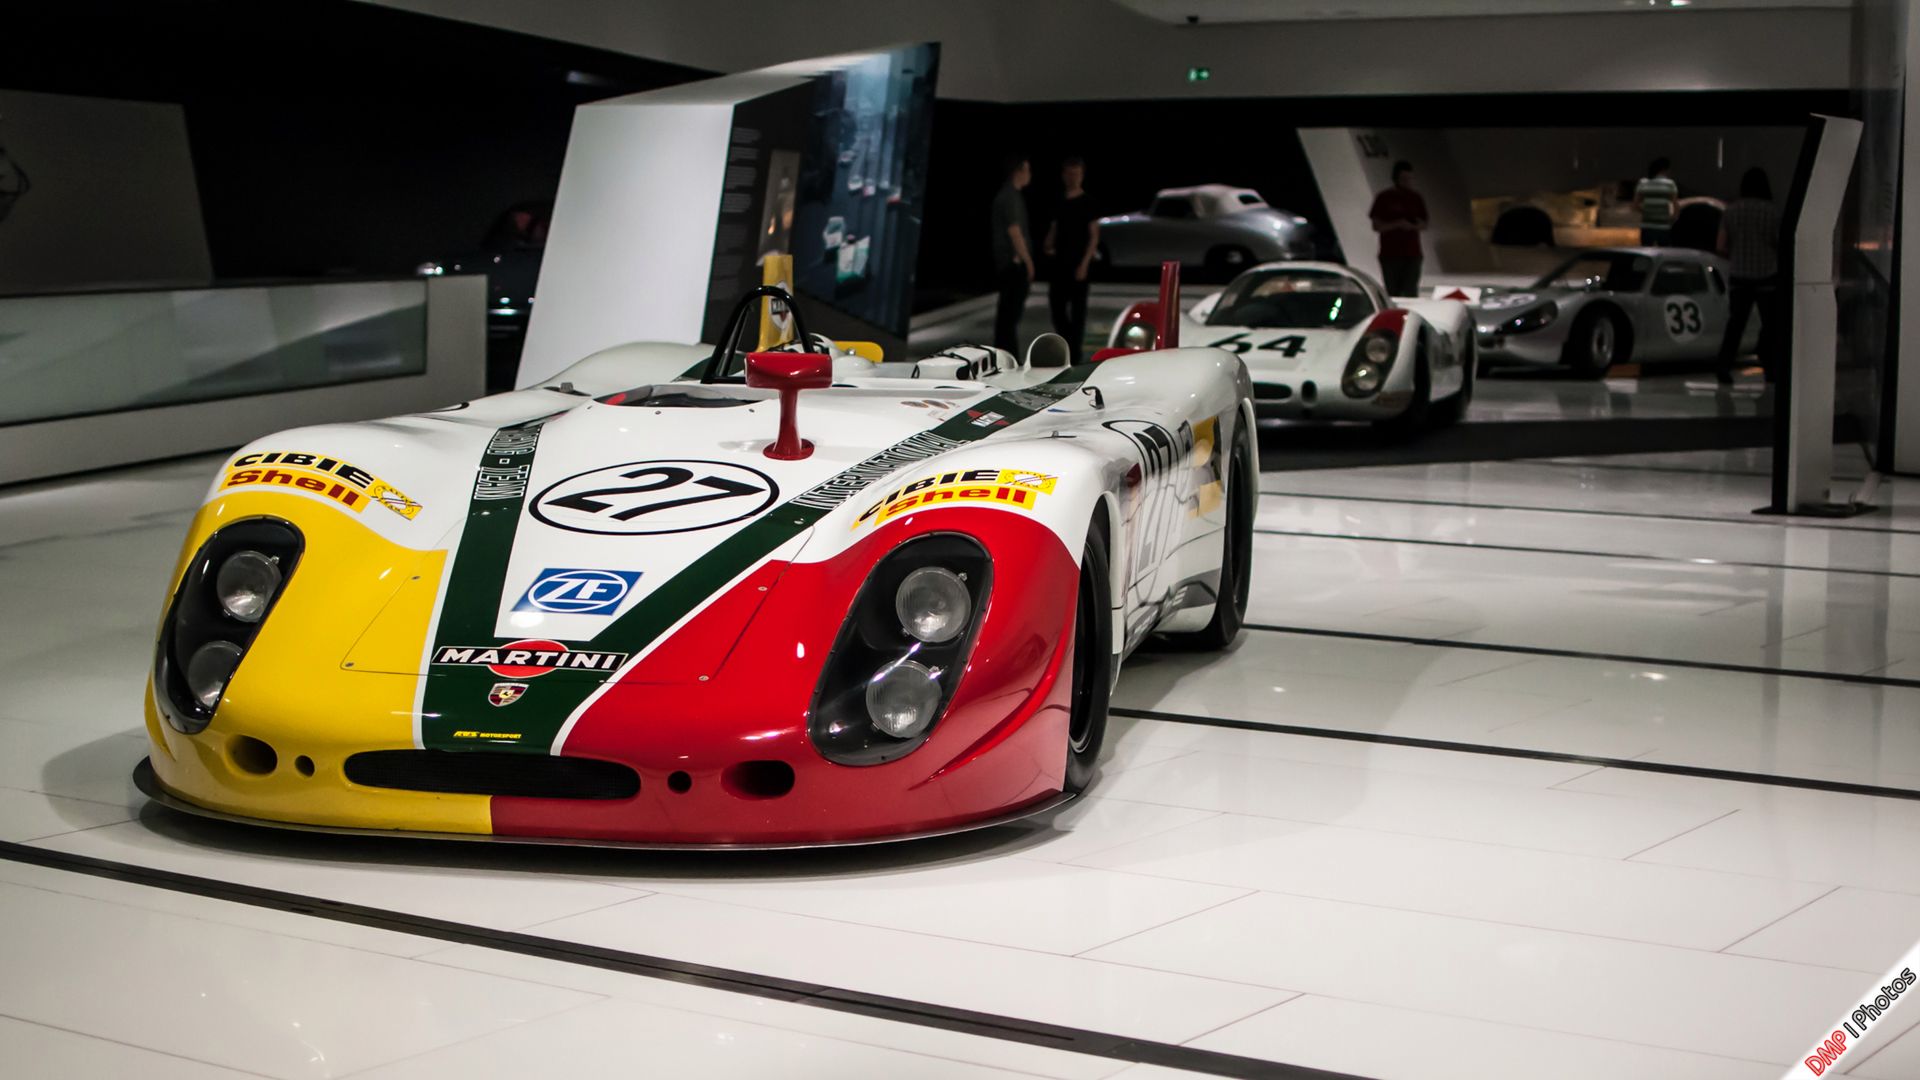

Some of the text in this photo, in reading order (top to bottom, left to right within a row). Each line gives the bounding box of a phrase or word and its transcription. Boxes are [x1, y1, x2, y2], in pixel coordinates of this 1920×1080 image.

[1667, 302, 1702, 334] 33
[1208, 332, 1307, 358] 64
[234, 452, 375, 489] CIBIE
[474, 465, 530, 500] TEAM
[792, 430, 972, 510] INTERNATIONAL
[227, 470, 360, 506] Shell
[544, 466, 767, 521] 27
[859, 469, 1000, 522] CIBIE
[886, 487, 1027, 517] Shell
[533, 577, 622, 605] ZF
[439, 648, 617, 669] MARTINI
